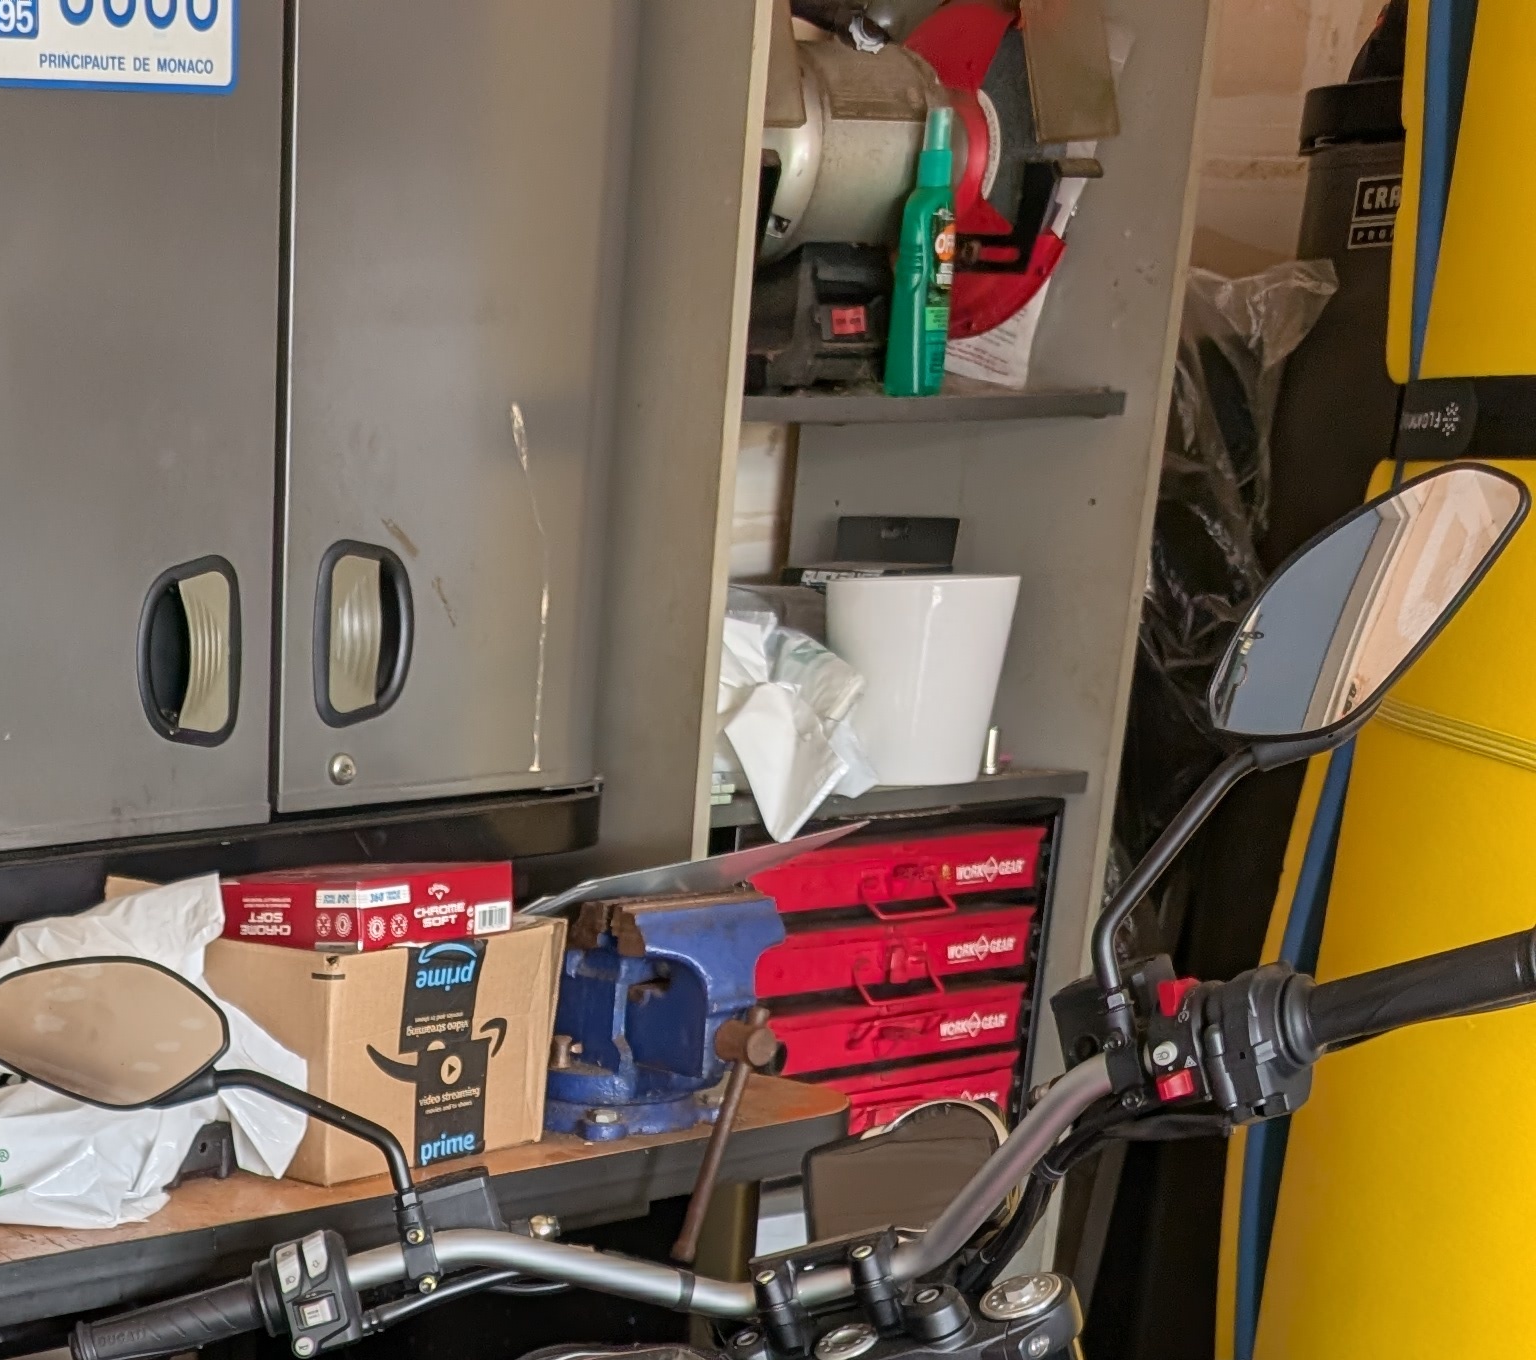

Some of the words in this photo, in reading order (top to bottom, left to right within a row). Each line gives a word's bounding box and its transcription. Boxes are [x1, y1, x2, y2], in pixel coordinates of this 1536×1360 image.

[39, 53, 126, 71] PRINCIPAUTE
[133, 57, 151, 72] DE
[156, 58, 214, 75] MONACO
[999, 859, 1026, 874] GEAR
[248, 912, 284, 924] SOFT
[414, 902, 465, 919] CHROME
[422, 914, 457, 928] SOFT
[240, 925, 291, 936] CHROME
[990, 937, 1016, 953] GEAR
[416, 960, 476, 991] prime
[406, 1021, 447, 1037] streaming
[447, 1020, 469, 1033] video
[982, 1014, 1008, 1029] GEAR
[419, 1092, 440, 1107] video
[442, 1086, 481, 1103] streaming
[420, 1133, 476, 1166] prime
